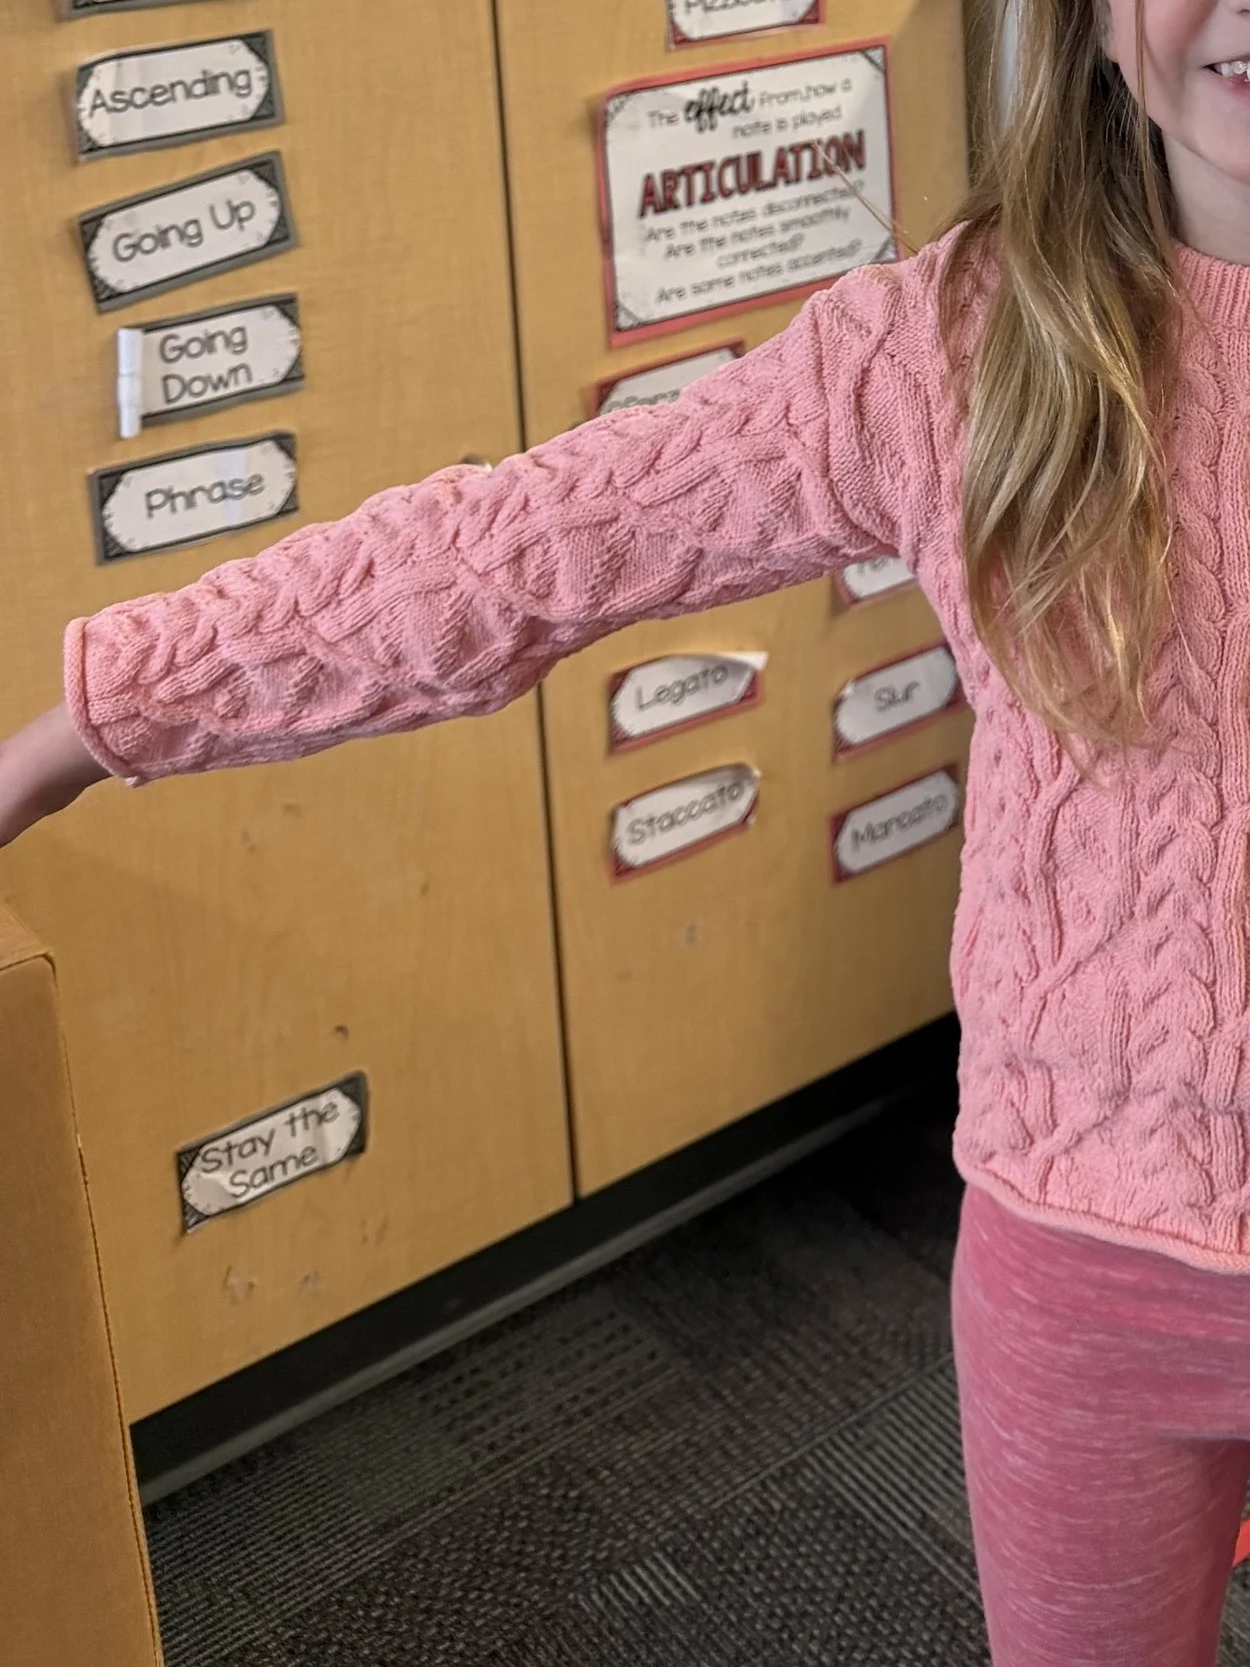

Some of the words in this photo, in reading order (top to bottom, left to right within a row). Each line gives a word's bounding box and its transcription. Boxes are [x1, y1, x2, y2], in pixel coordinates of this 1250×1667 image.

[87, 68, 252, 118] Ascending
[648, 110, 680, 129] The
[684, 81, 754, 133] effect
[731, 119, 772, 138] note
[776, 116, 788, 131] is
[792, 105, 843, 130] played
[638, 130, 866, 219] ARTICULATION
[112, 216, 204, 263] Going
[209, 197, 256, 233] Up
[646, 225, 676, 242] Are
[680, 218, 708, 232] the
[711, 208, 756, 226] notes
[664, 242, 695, 259] Are
[700, 234, 727, 249] the
[730, 224, 776, 242] notes
[779, 205, 850, 231] smoothly
[656, 286, 686, 303] Are
[691, 275, 736, 296] some
[738, 264, 783, 283] notes
[159, 324, 249, 364] Going
[161, 360, 253, 404] Down
[144, 470, 267, 519] Phrase
[634, 663, 729, 712] Legato
[873, 679, 921, 713] Slur
[625, 781, 745, 845] Staccato
[850, 792, 949, 851] Marcato
[199, 1127, 277, 1174] Stay
[283, 1100, 340, 1137] the
[229, 1145, 320, 1199] Same
